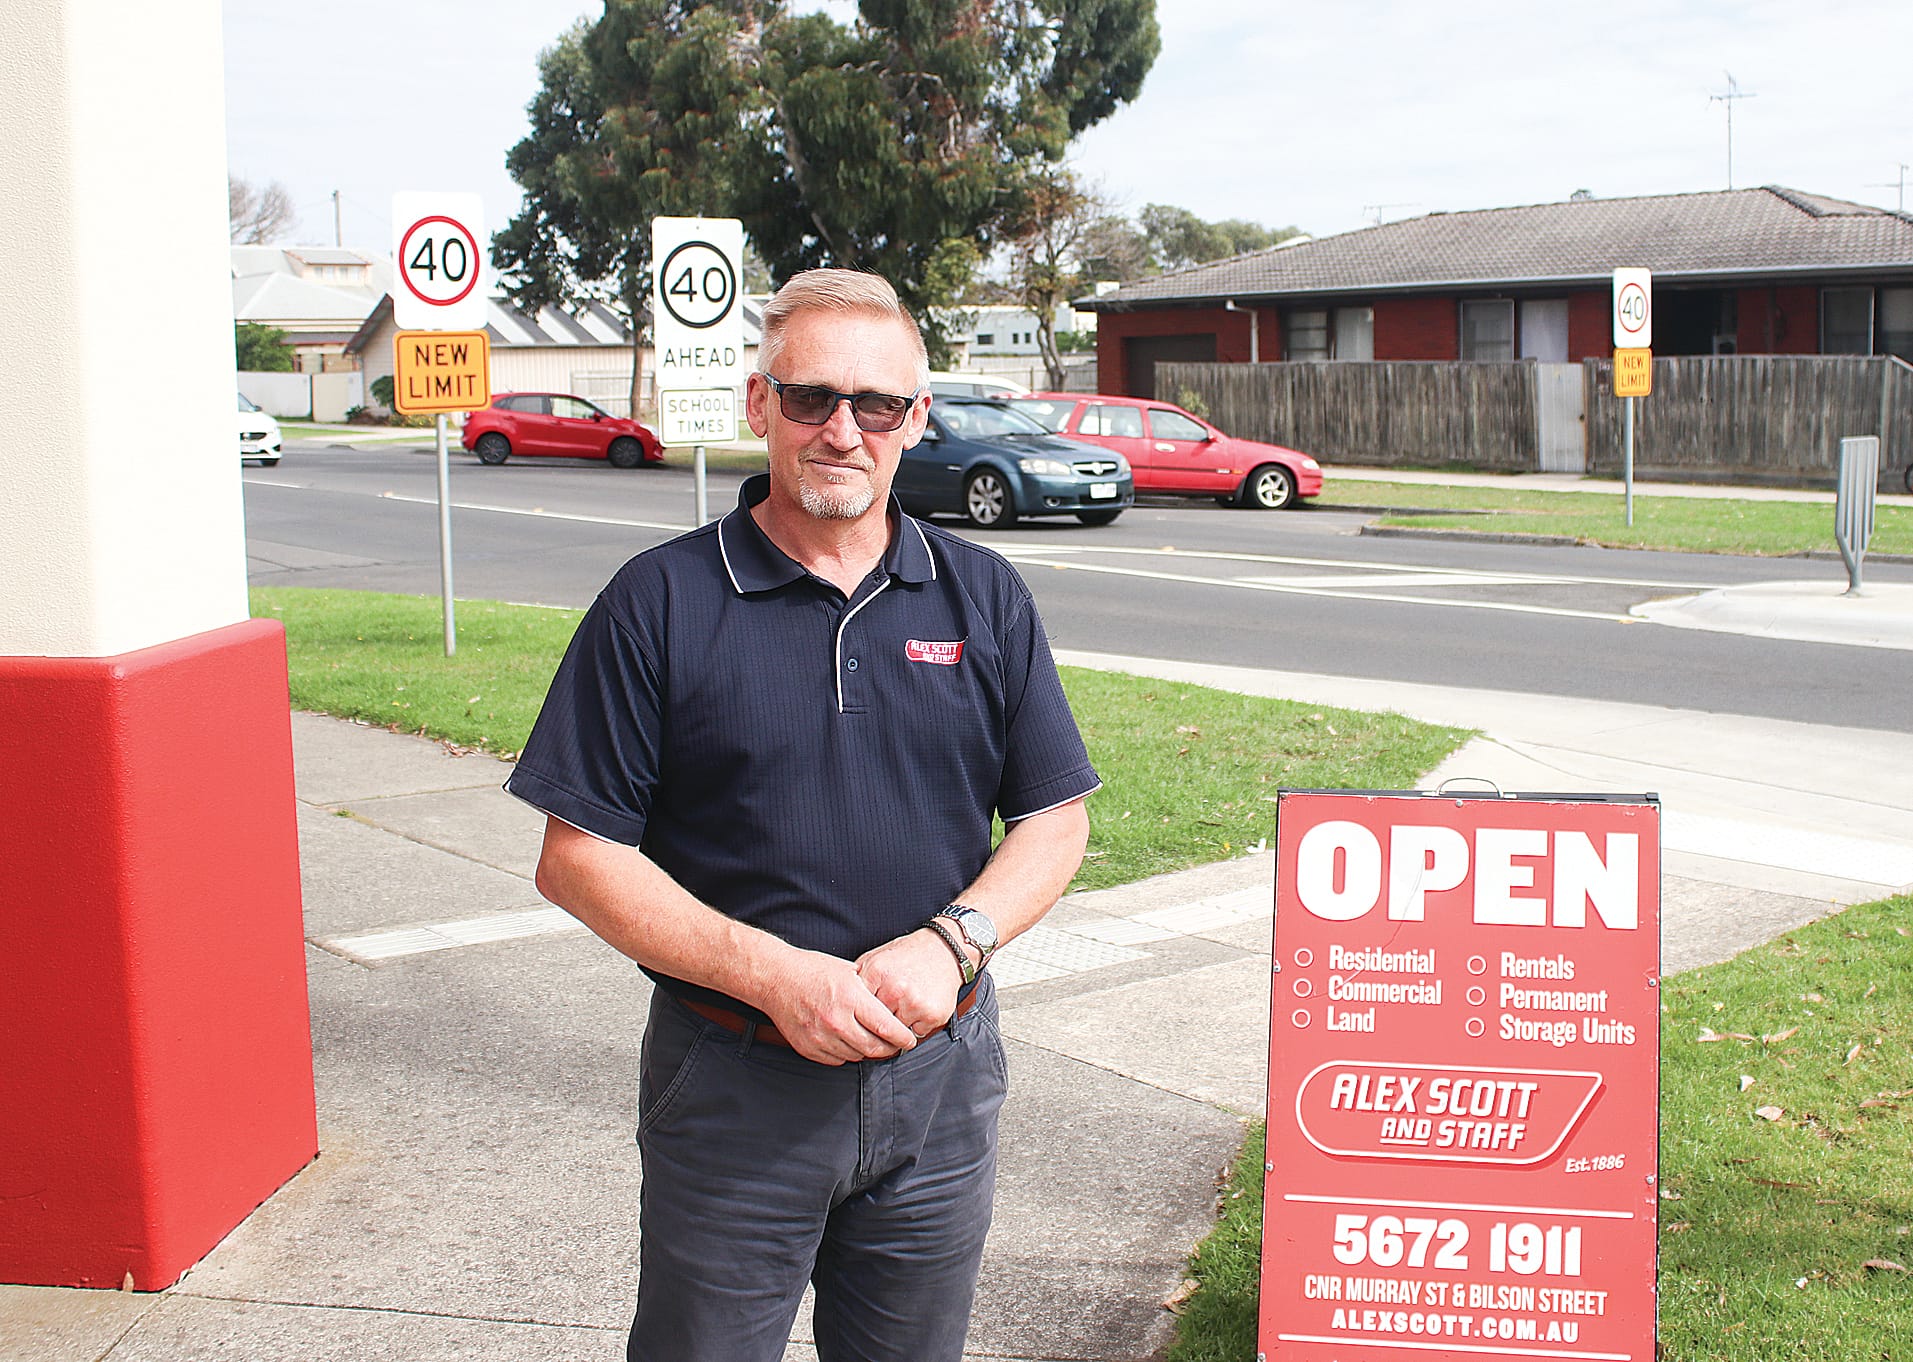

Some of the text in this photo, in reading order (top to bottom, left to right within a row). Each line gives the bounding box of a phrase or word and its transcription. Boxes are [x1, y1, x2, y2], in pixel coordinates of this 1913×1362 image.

[410, 237, 467, 282] 40
[669, 266, 728, 303] 40
[1622, 296, 1644, 320] 40
[415, 343, 469, 367] NEW
[663, 347, 736, 368] AHEAD
[1623, 355, 1645, 370] NEW
[408, 374, 478, 400] LIMIT
[1621, 373, 1646, 388] LIMIT
[667, 397, 730, 413] SCHOOL
[677, 418, 725, 434] TIMES
[910, 641, 958, 654] ALEX SCOTT
[1296, 820, 1640, 931] OPEN
[1329, 945, 1435, 975] Residential
[1500, 952, 1575, 981] Rentals
[1328, 975, 1442, 1006] Commercial
[1500, 983, 1608, 1013] Permanent
[1327, 1005, 1375, 1033] Land
[1500, 1014, 1636, 1047] Storage Units
[1330, 1073, 1538, 1119] ALEX SCOTT
[1381, 1117, 1527, 1151] AND STAFF
[1332, 1213, 1583, 1277] 5672 1911
[1304, 1274, 1608, 1317] CNR MURRAY ST & BILSON STREET
[1331, 1309, 1579, 1343] ALEXSCOTT.COM.AU
